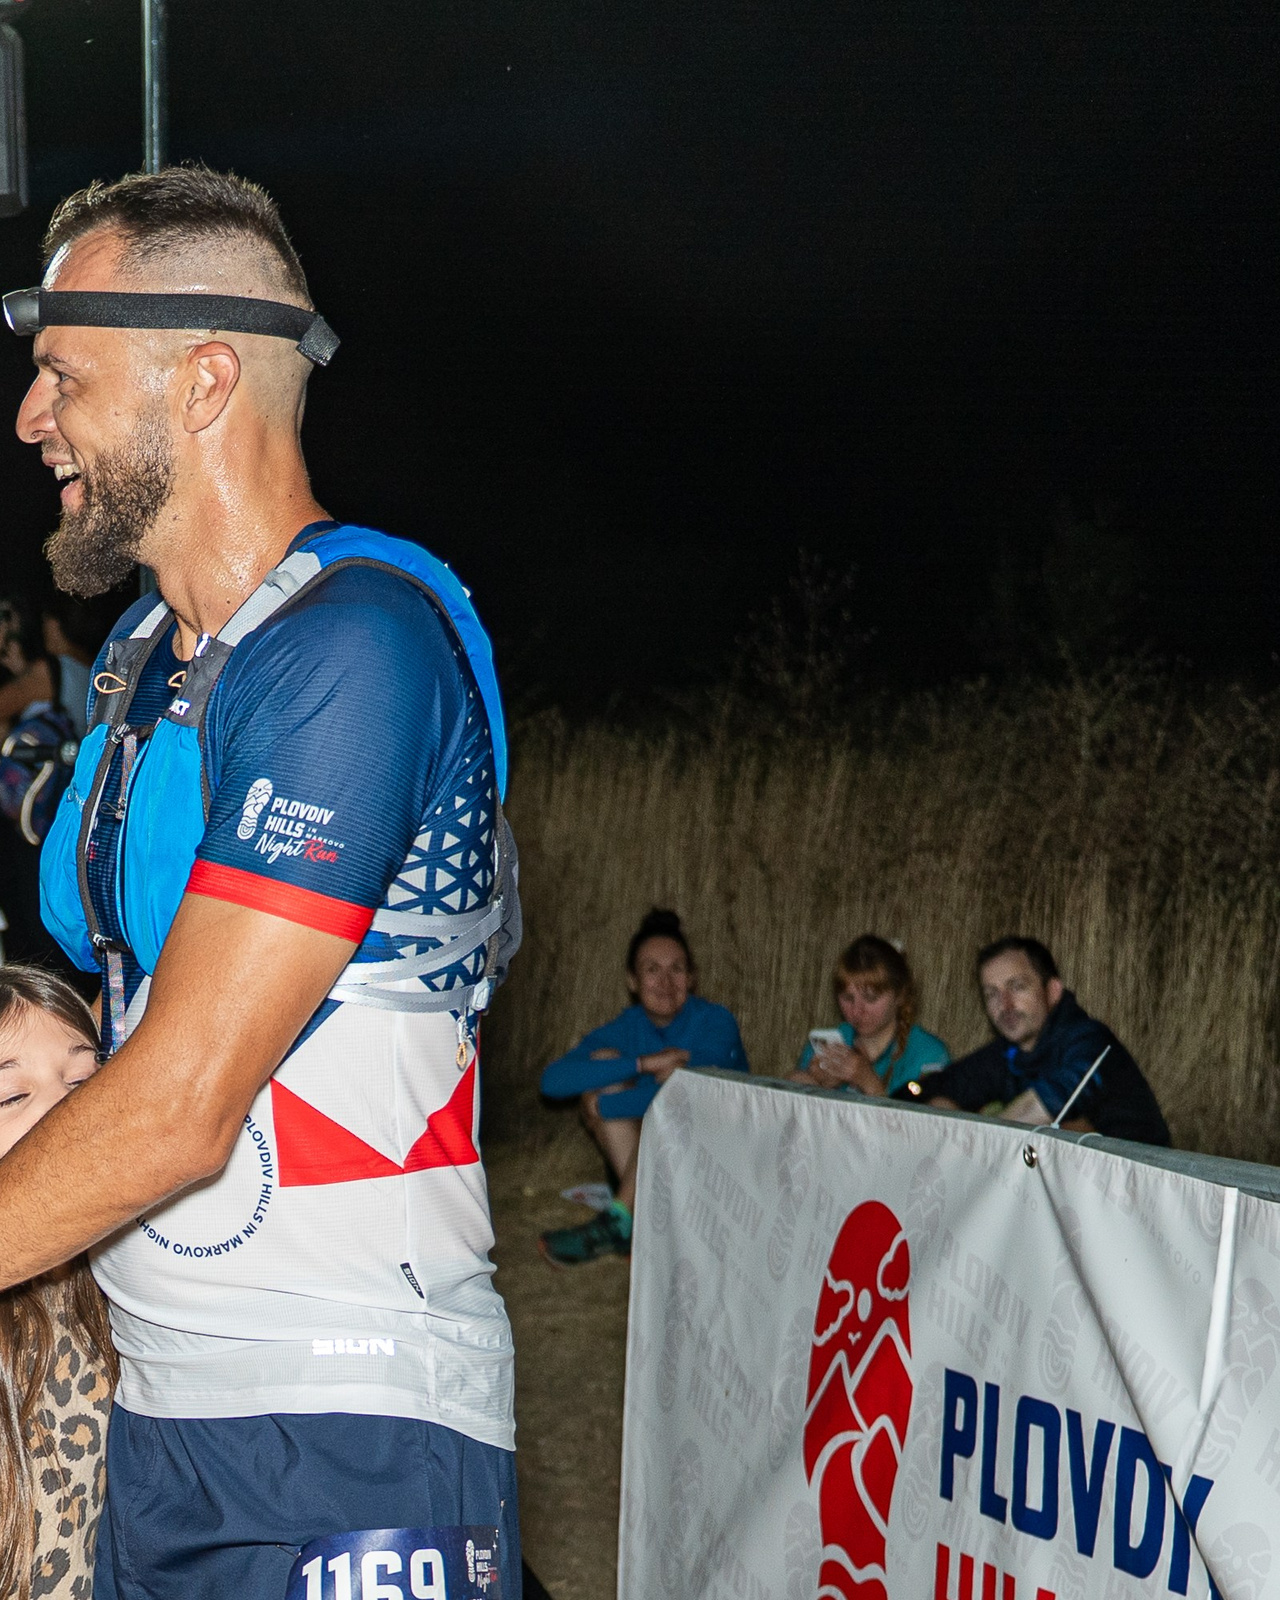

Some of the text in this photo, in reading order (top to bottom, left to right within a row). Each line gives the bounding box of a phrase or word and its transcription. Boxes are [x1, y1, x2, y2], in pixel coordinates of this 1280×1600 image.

[271, 797, 335, 825] PLOVDIV
[264, 815, 306, 838] HILLS
[254, 833, 339, 864] Night Run
[243, 1114, 273, 1178] PLOVDIV
[253, 1183, 273, 1224] HILLS
[242, 1222, 258, 1239] IN
[173, 1234, 244, 1258] MARKOVO
